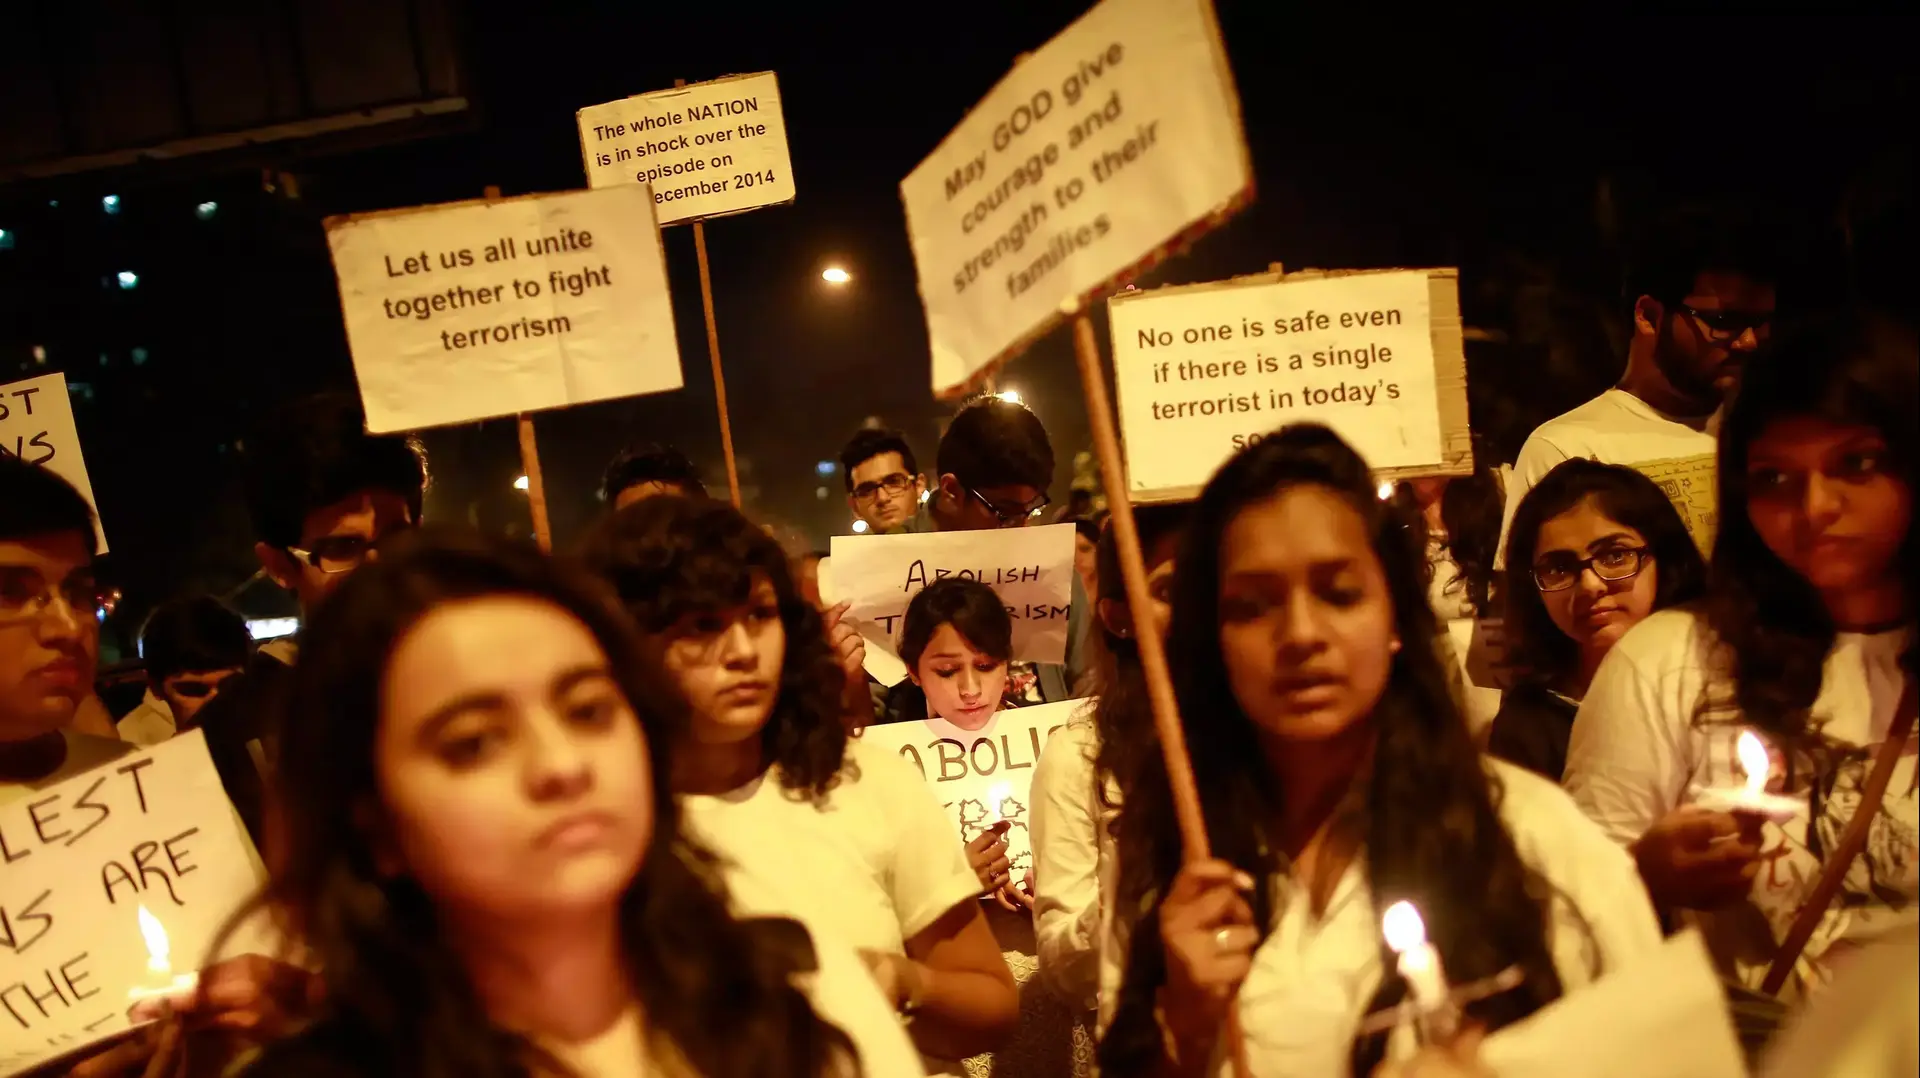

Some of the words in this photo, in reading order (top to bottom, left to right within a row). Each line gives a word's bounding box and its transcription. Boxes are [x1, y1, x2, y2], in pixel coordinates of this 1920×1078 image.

[593, 125, 625, 141] The
[630, 111, 682, 133] whole
[687, 97, 758, 121] NATION
[943, 151, 987, 202] May
[992, 89, 1054, 153] GOD
[1061, 41, 1124, 106] give
[596, 152, 611, 167] is
[616, 147, 631, 162] in
[637, 135, 689, 157] shock
[694, 128, 733, 146] over
[738, 122, 766, 139] the
[960, 142, 1059, 235] courage
[1067, 90, 1122, 150] and
[637, 157, 705, 183] episode
[711, 153, 733, 168] on
[654, 179, 729, 204] ecember
[734, 169, 775, 190] 2014
[952, 200, 1048, 294] strength
[1054, 177, 1084, 210] to
[1091, 119, 1159, 185] their
[384, 251, 431, 278] Let
[440, 248, 474, 270] us
[484, 238, 516, 264] all
[525, 227, 594, 257] unite
[1004, 213, 1112, 299] families
[384, 283, 505, 322] together
[513, 278, 541, 300] to
[549, 265, 613, 297] fight
[441, 315, 572, 351] terrorism
[1138, 328, 1173, 349] No
[1184, 324, 1233, 344] one
[1242, 318, 1264, 338] is
[1274, 310, 1330, 335] safe
[1340, 308, 1402, 329] even
[1153, 363, 1168, 383] if
[1178, 358, 1247, 382] there
[1257, 353, 1279, 374] is
[1289, 353, 1302, 371] a
[1312, 343, 1392, 371] single
[1152, 391, 1261, 421] terrorist
[1270, 388, 1293, 410] in
[875, 603, 1070, 635] TRISM
[102, 826, 199, 906] ARE
[0, 952, 100, 1029] THE
